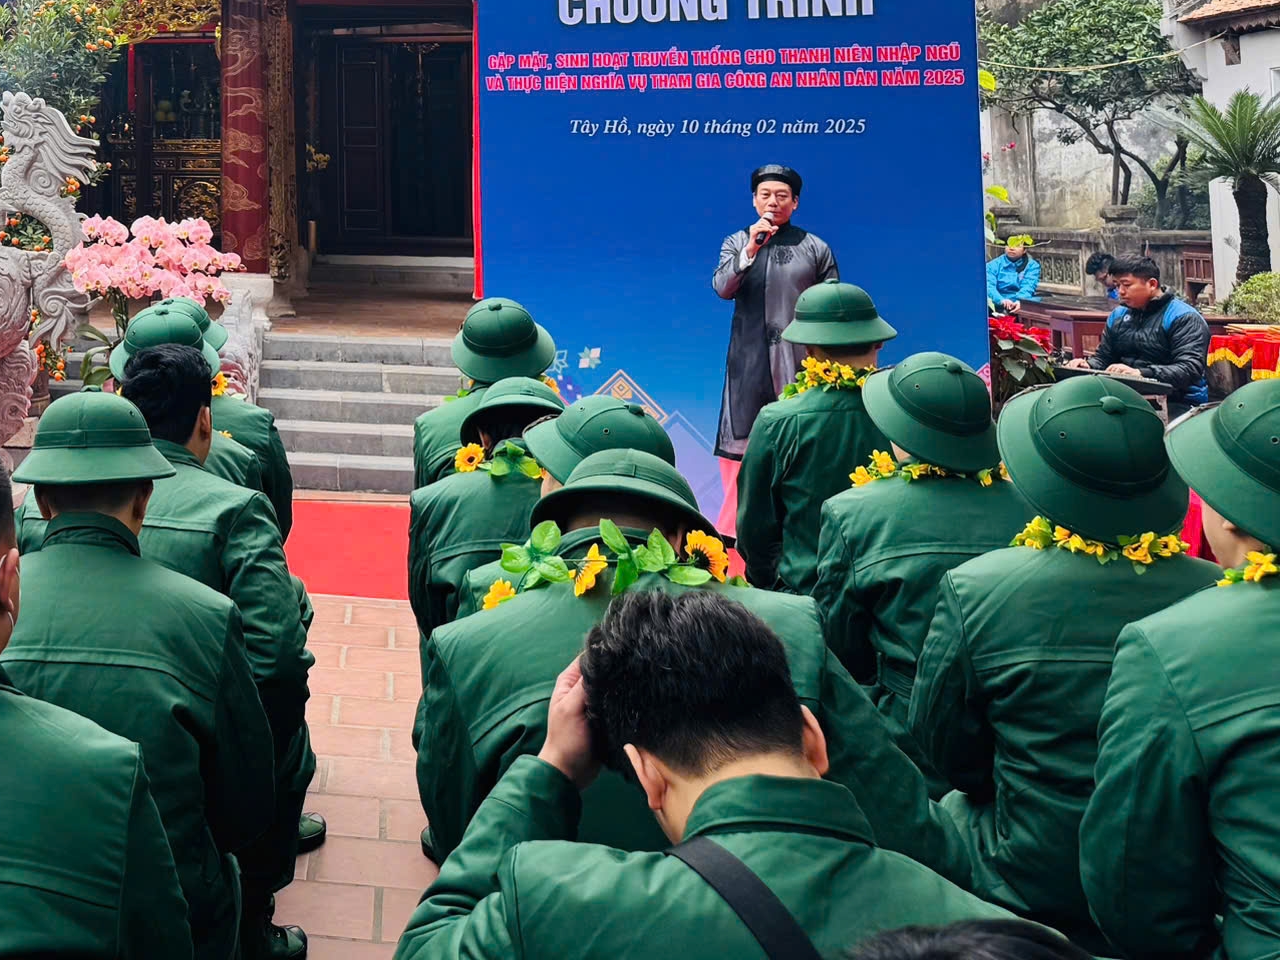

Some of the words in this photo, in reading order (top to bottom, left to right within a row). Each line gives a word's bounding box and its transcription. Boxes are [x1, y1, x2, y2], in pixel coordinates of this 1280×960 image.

[488, 52, 515, 72] GẶP
[518, 51, 552, 71] MẶT,
[555, 53, 589, 68] SINH
[593, 52, 629, 70] HOẠT
[632, 47, 688, 67] TRUYỀN
[691, 45, 741, 66] THỐNG
[744, 49, 776, 65] CHO
[779, 48, 831, 64] THANH
[834, 44, 873, 63] NIÊN
[877, 43, 921, 65] NHẬP
[925, 42, 960, 61] NGŨ
[486, 74, 504, 91] VÀ
[506, 75, 541, 93] THỰC
[544, 73, 577, 93] HIỆN
[581, 72, 625, 90] NGHĨA
[628, 74, 647, 92] VỤ
[650, 74, 692, 89] THAM
[696, 73, 721, 88] GIA
[725, 70, 767, 88] CÔNG
[770, 72, 792, 87] AN
[796, 68, 840, 87] NHÂN
[844, 68, 878, 86] DÂN
[882, 67, 920, 86] NĂM
[924, 69, 965, 85] 2025
[571, 120, 599, 136] Tây
[604, 117, 631, 135] Hồ,
[638, 120, 674, 136] ngày
[681, 120, 699, 133] 10
[704, 120, 751, 136] tháng
[757, 120, 776, 133] 02
[782, 120, 818, 133] năm
[825, 119, 865, 133] 2025
